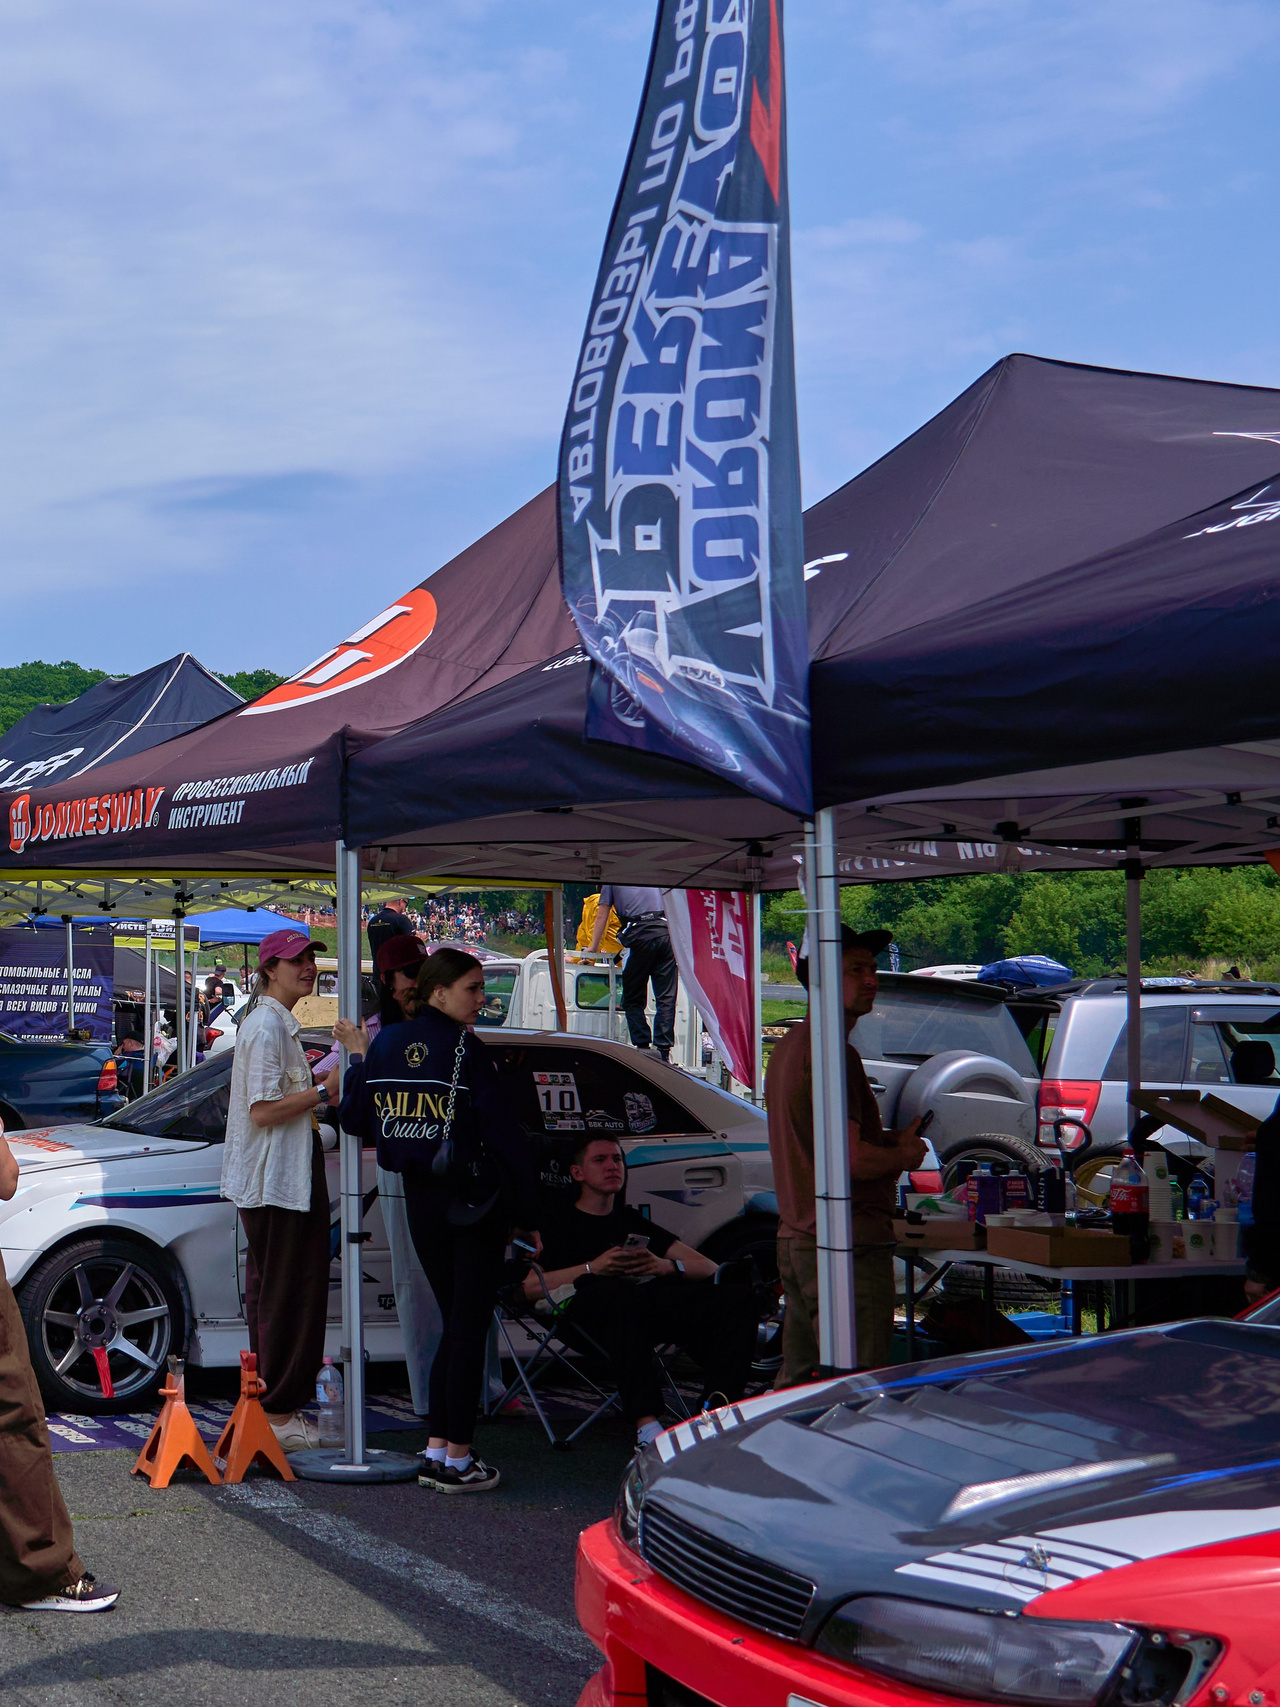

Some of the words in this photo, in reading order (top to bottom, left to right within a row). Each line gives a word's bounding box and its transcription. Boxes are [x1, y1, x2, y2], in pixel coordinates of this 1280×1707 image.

[172, 757, 315, 801] ПРОФЕССИОНАЛЬНЫЙ
[30, 787, 165, 842] JONNESWAY
[167, 800, 246, 830] ИНСТРУМЕНТ
[50, 984, 102, 997] МАТРИАЛЫ
[6, 1000, 26, 1012] ВСЕХ
[29, 1000, 58, 1014] ВИДОВ
[374, 1091, 455, 1121] SAILING
[541, 1089, 576, 1112] 10
[381, 1107, 439, 1139] Cruise
[605, 1121, 624, 1129] AUTO
[1037, 1177, 1045, 1210] Rich
